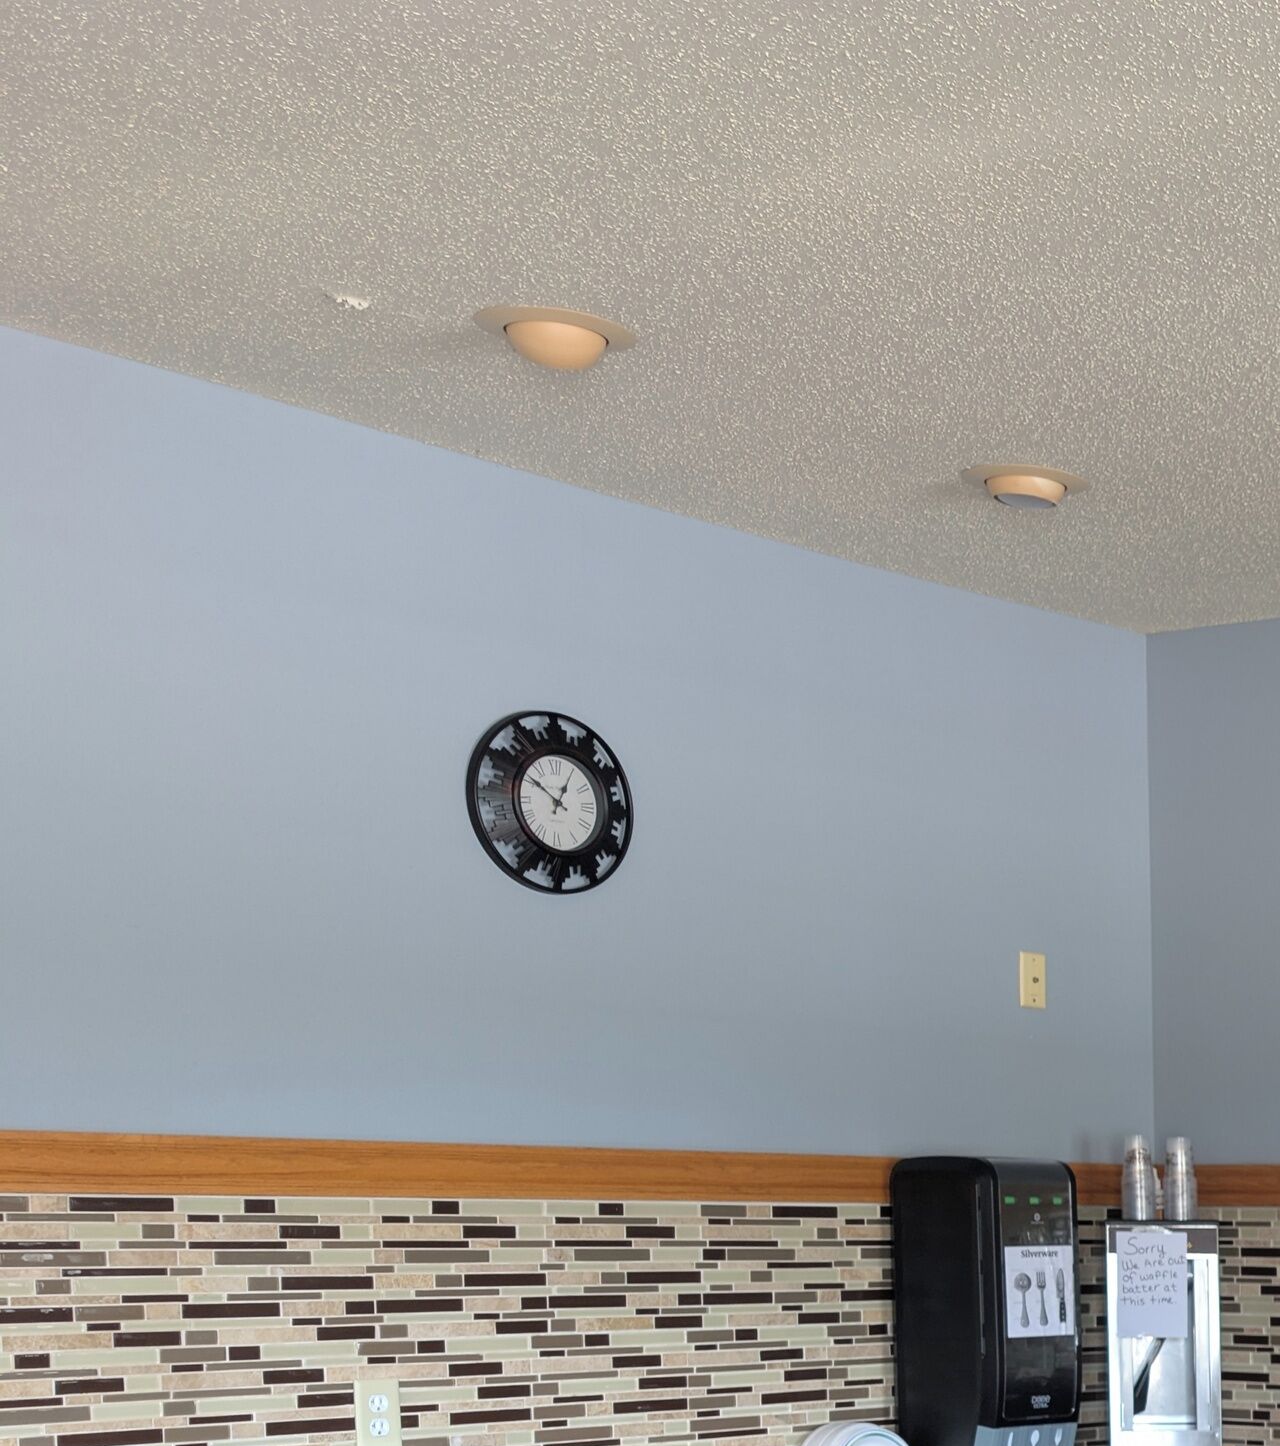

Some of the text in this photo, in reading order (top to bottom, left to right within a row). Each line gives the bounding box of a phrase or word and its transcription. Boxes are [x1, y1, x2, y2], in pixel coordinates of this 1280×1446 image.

[1123, 1236, 1166, 1258] Sorry
[1021, 1250, 1058, 1258] Silverware
[1122, 1259, 1138, 1271] We
[1168, 1255, 1187, 1265] out
[1122, 1270, 1177, 1284] of waffle
[1122, 1282, 1177, 1294] batter at
[1120, 1296, 1145, 1305] this
